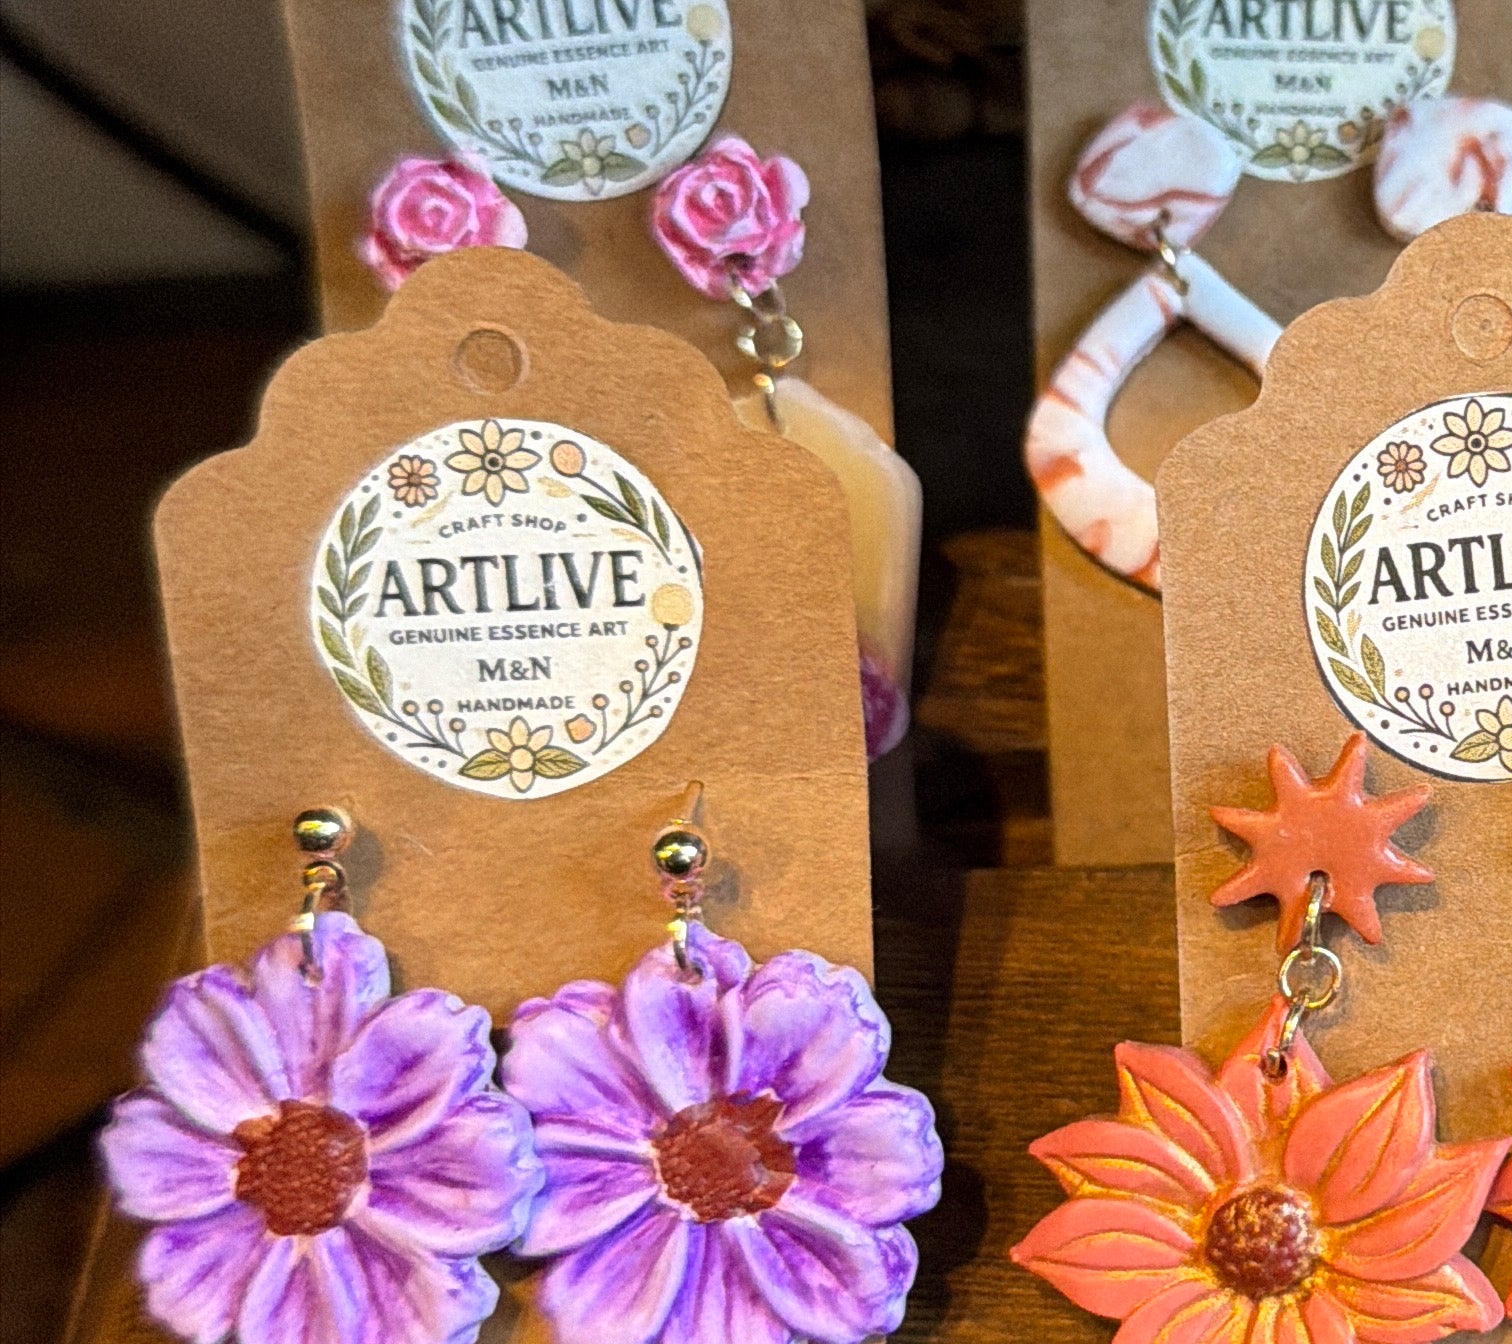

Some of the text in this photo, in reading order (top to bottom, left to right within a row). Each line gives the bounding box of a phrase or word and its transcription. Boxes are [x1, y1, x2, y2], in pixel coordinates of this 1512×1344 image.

[636, 39, 669, 53] ART
[547, 74, 609, 101] M&N
[1427, 494, 1488, 522] CRAFT
[439, 513, 567, 539] CRAFT SHOP
[374, 550, 645, 618] ARTLIVE
[1382, 608, 1469, 632] GENUINE
[389, 621, 629, 645] GENUINE ESSENCE ART
[477, 657, 552, 682] M&N
[458, 696, 576, 713] HANDMADE
